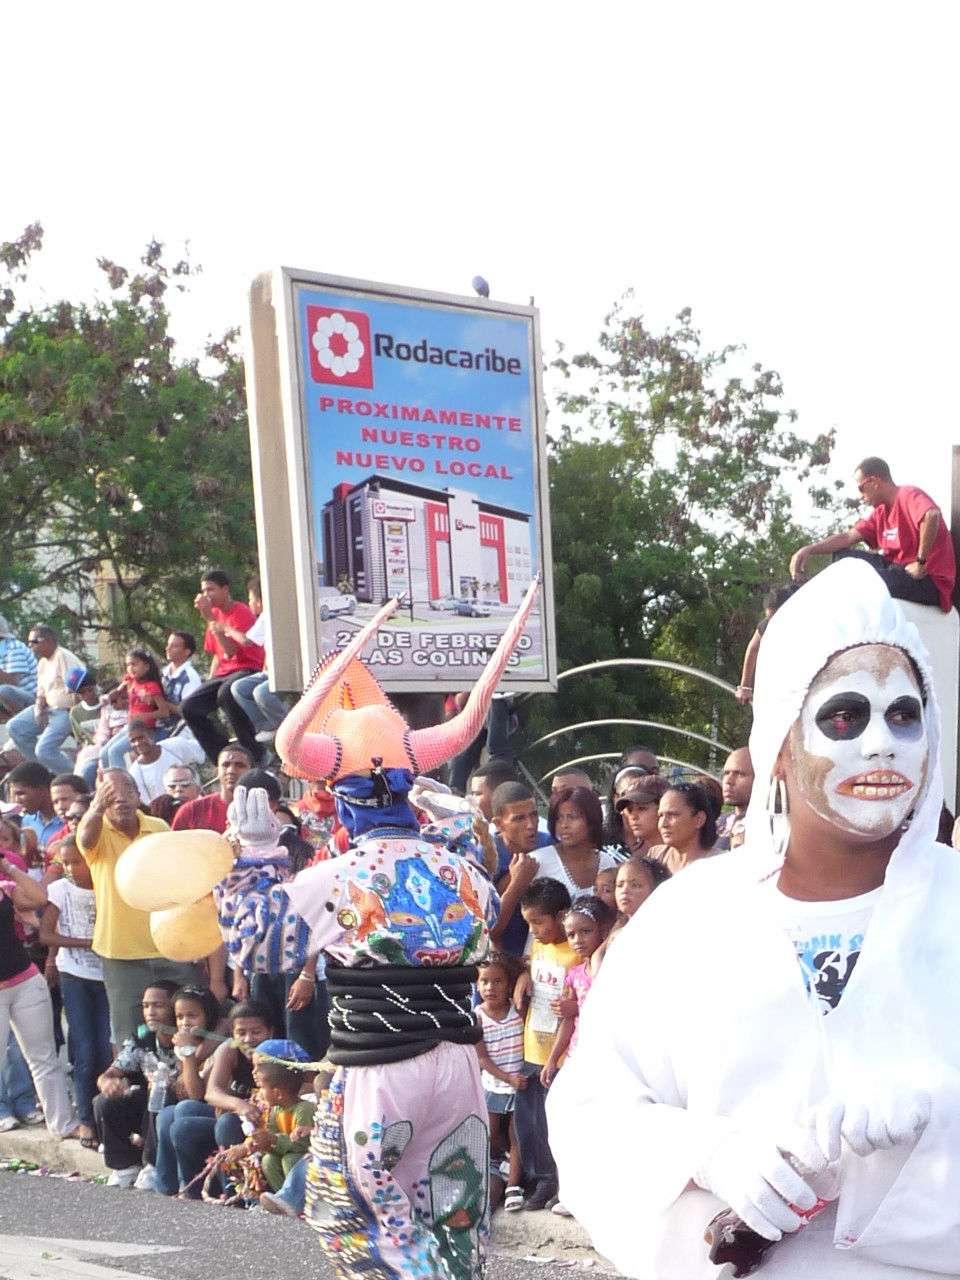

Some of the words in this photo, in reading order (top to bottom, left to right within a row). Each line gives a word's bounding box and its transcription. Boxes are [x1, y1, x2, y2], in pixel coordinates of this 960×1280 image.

[374, 333, 521, 375] Rodacaribe
[319, 396, 522, 432] PROXIMAMENTE
[361, 427, 481, 453] NUESTRO
[336, 450, 425, 473] NUEVO
[435, 459, 514, 480] LOCAL
[377, 632, 412, 648] DE
[420, 632, 533, 650] FEBREO
[412, 650, 520, 667] COLINS
